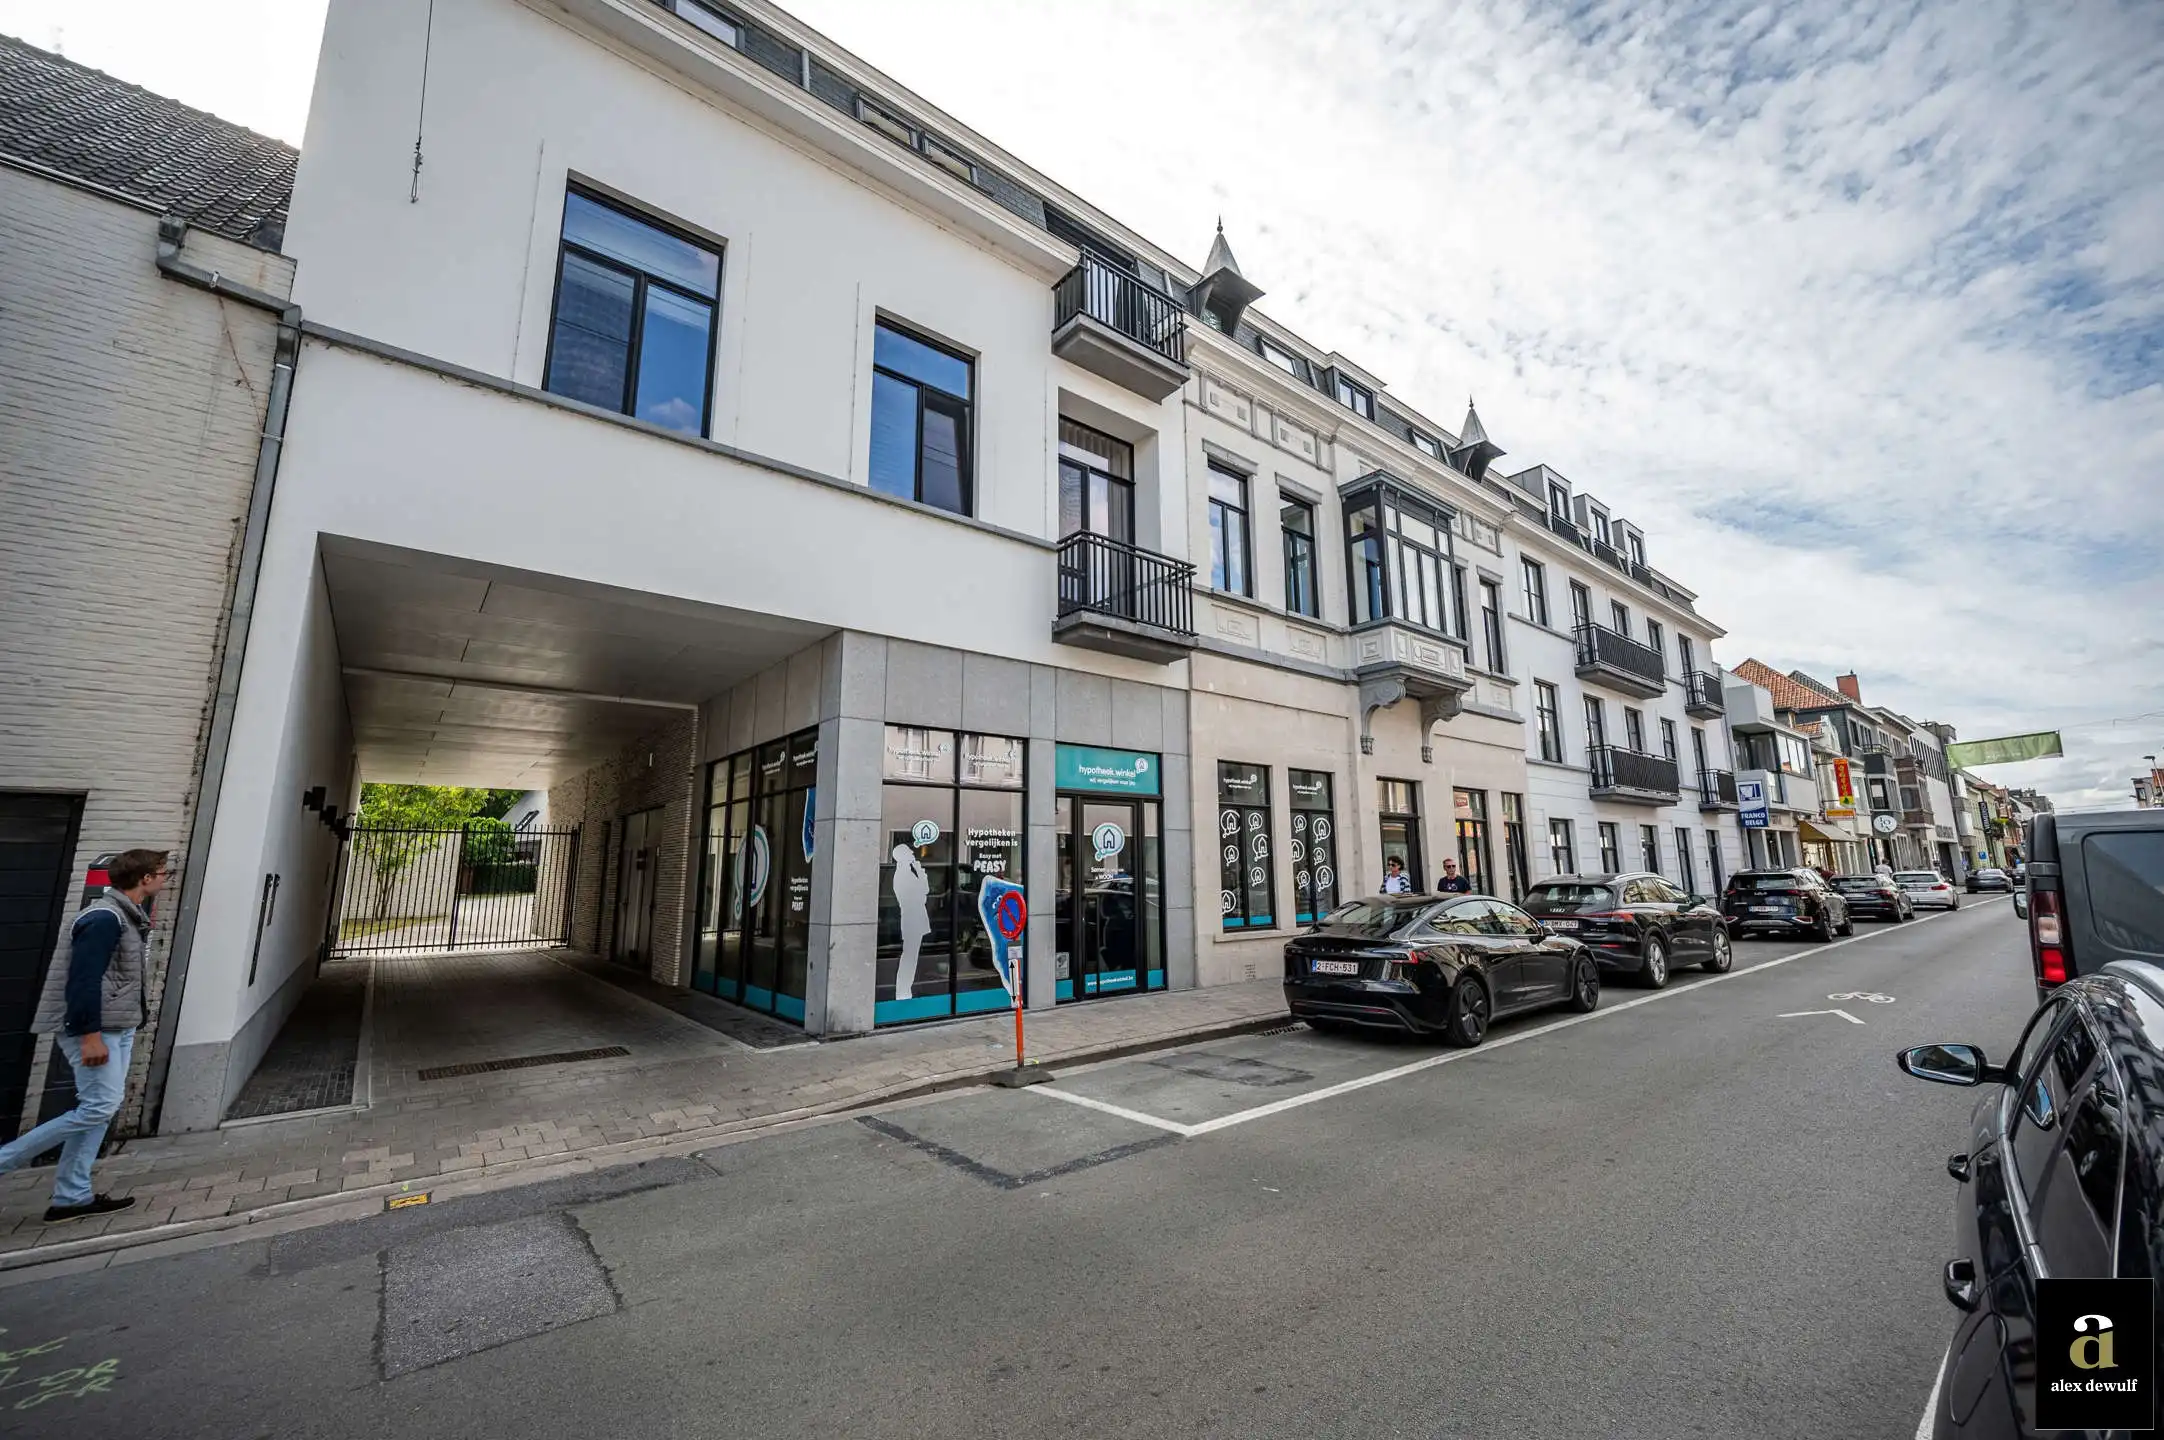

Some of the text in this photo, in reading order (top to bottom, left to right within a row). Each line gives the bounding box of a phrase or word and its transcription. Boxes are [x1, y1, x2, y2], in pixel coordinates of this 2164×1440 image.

[1741, 812, 1766, 820] FRANCO
[968, 828, 1016, 837] Hypotheken
[965, 838, 1010, 848] vergelijken
[973, 860, 1006, 872] PEASY
